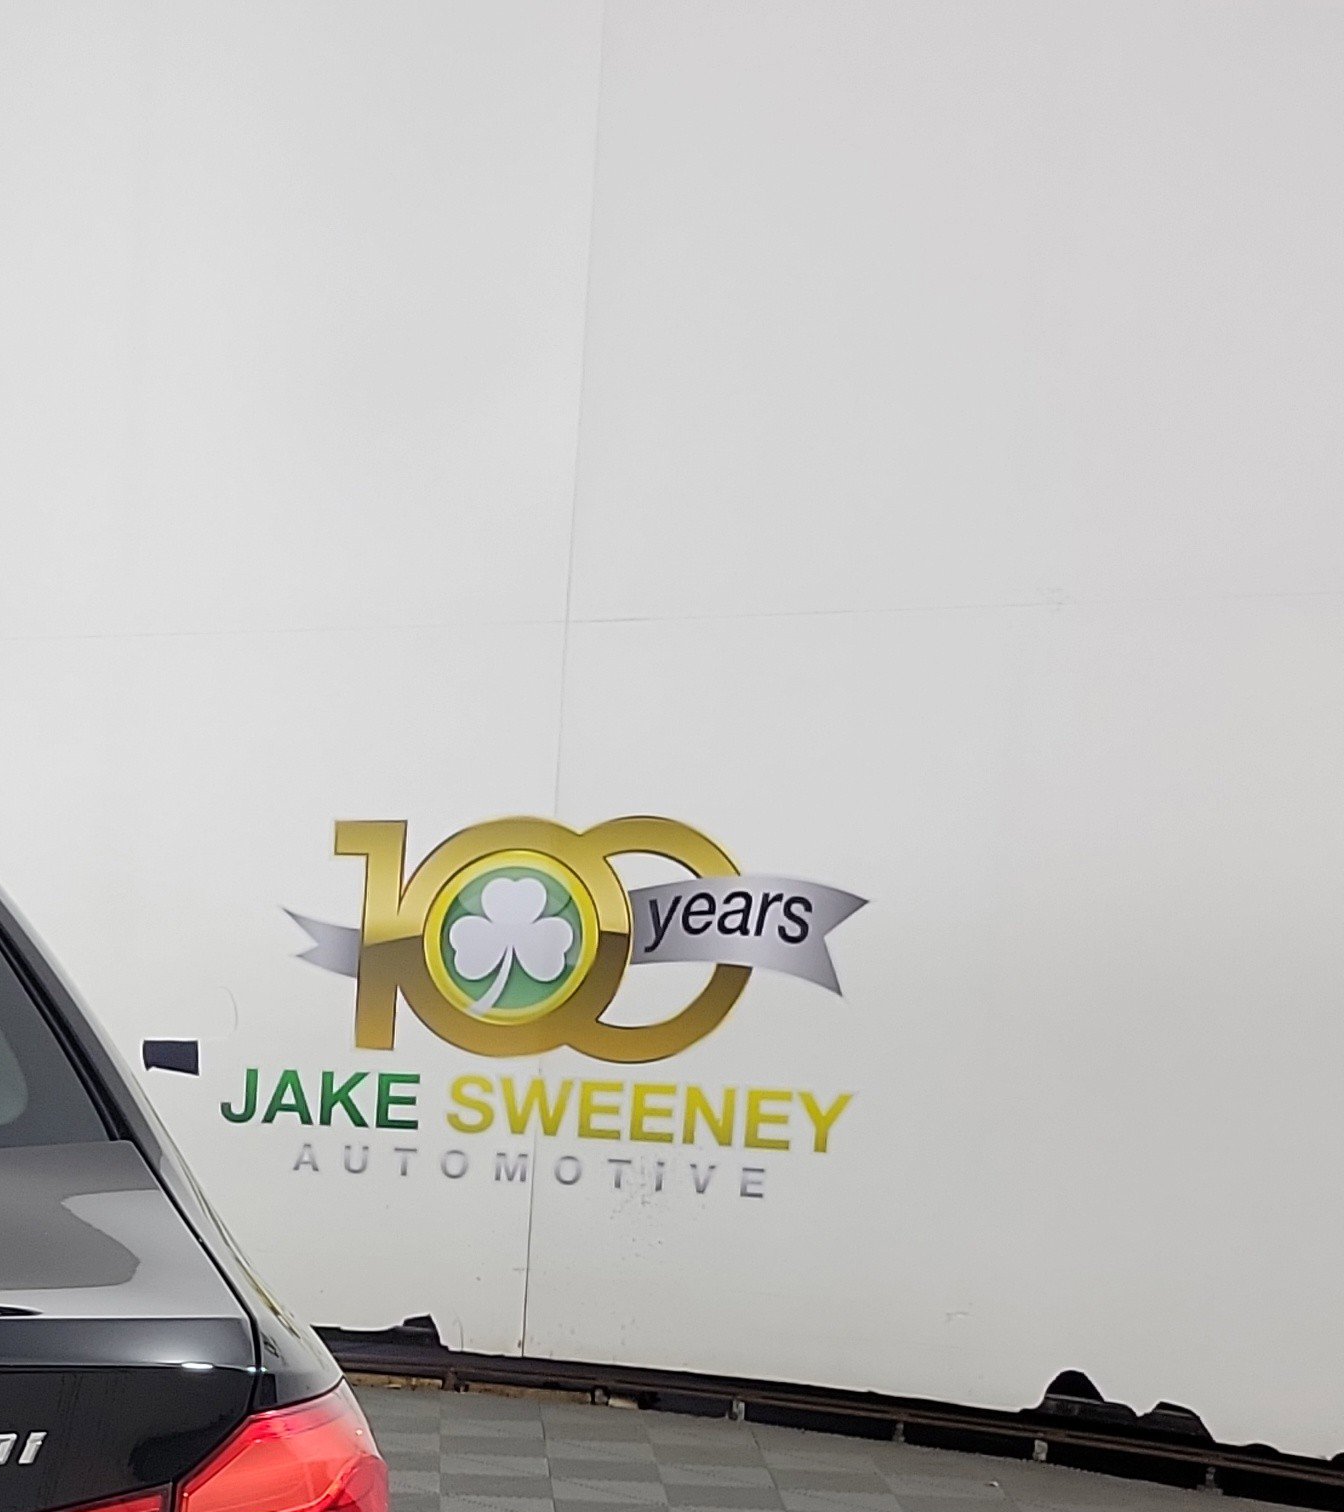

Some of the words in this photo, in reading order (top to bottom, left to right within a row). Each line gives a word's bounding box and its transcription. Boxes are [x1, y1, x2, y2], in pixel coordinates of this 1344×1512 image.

[334, 815, 753, 1064] 100
[644, 890, 813, 952] years
[220, 1067, 421, 1130] JAKE
[446, 1074, 853, 1153] SWEENEY
[293, 1144, 767, 1199] AUTOMOTIVE
